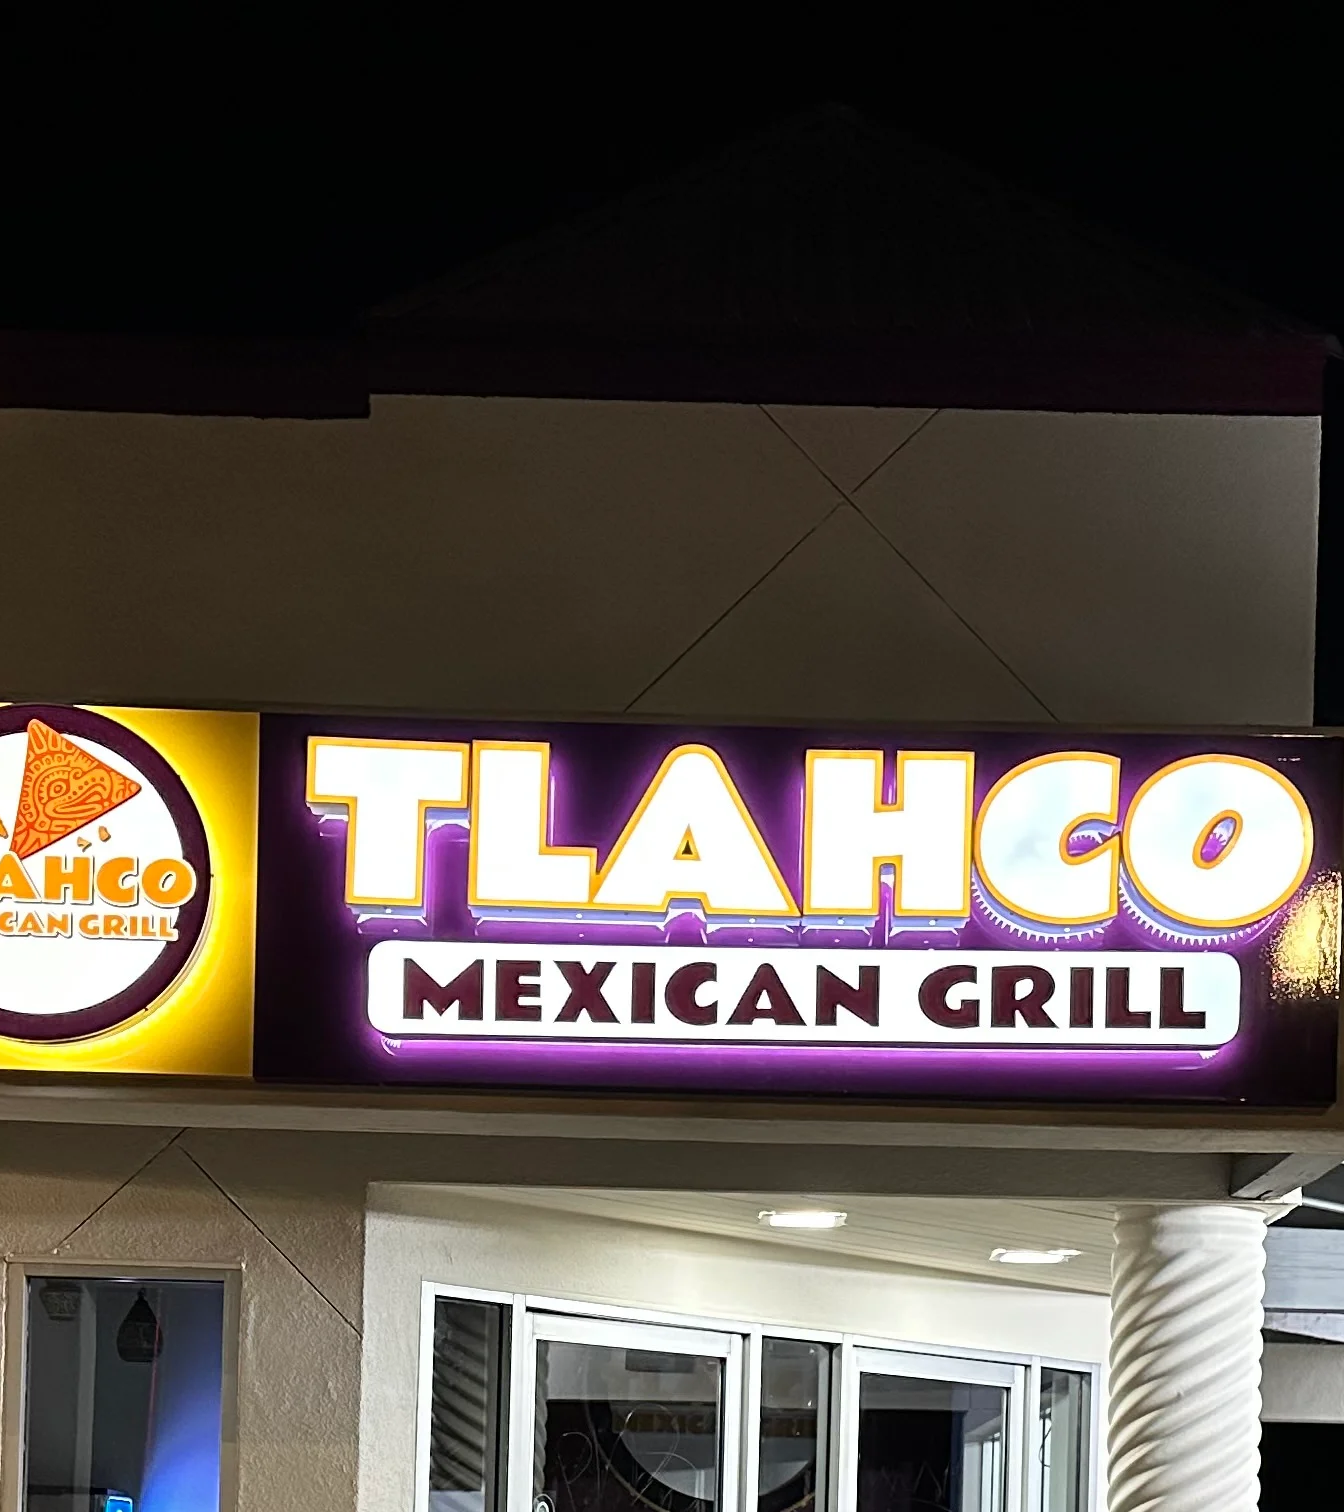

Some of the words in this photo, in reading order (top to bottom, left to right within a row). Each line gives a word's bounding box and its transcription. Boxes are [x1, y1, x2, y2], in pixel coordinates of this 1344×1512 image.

[306, 736, 1314, 928] TLAHCO
[77, 913, 174, 938] GRILL
[402, 957, 881, 1027] MEXICAN
[917, 964, 1207, 1029] GRILL
